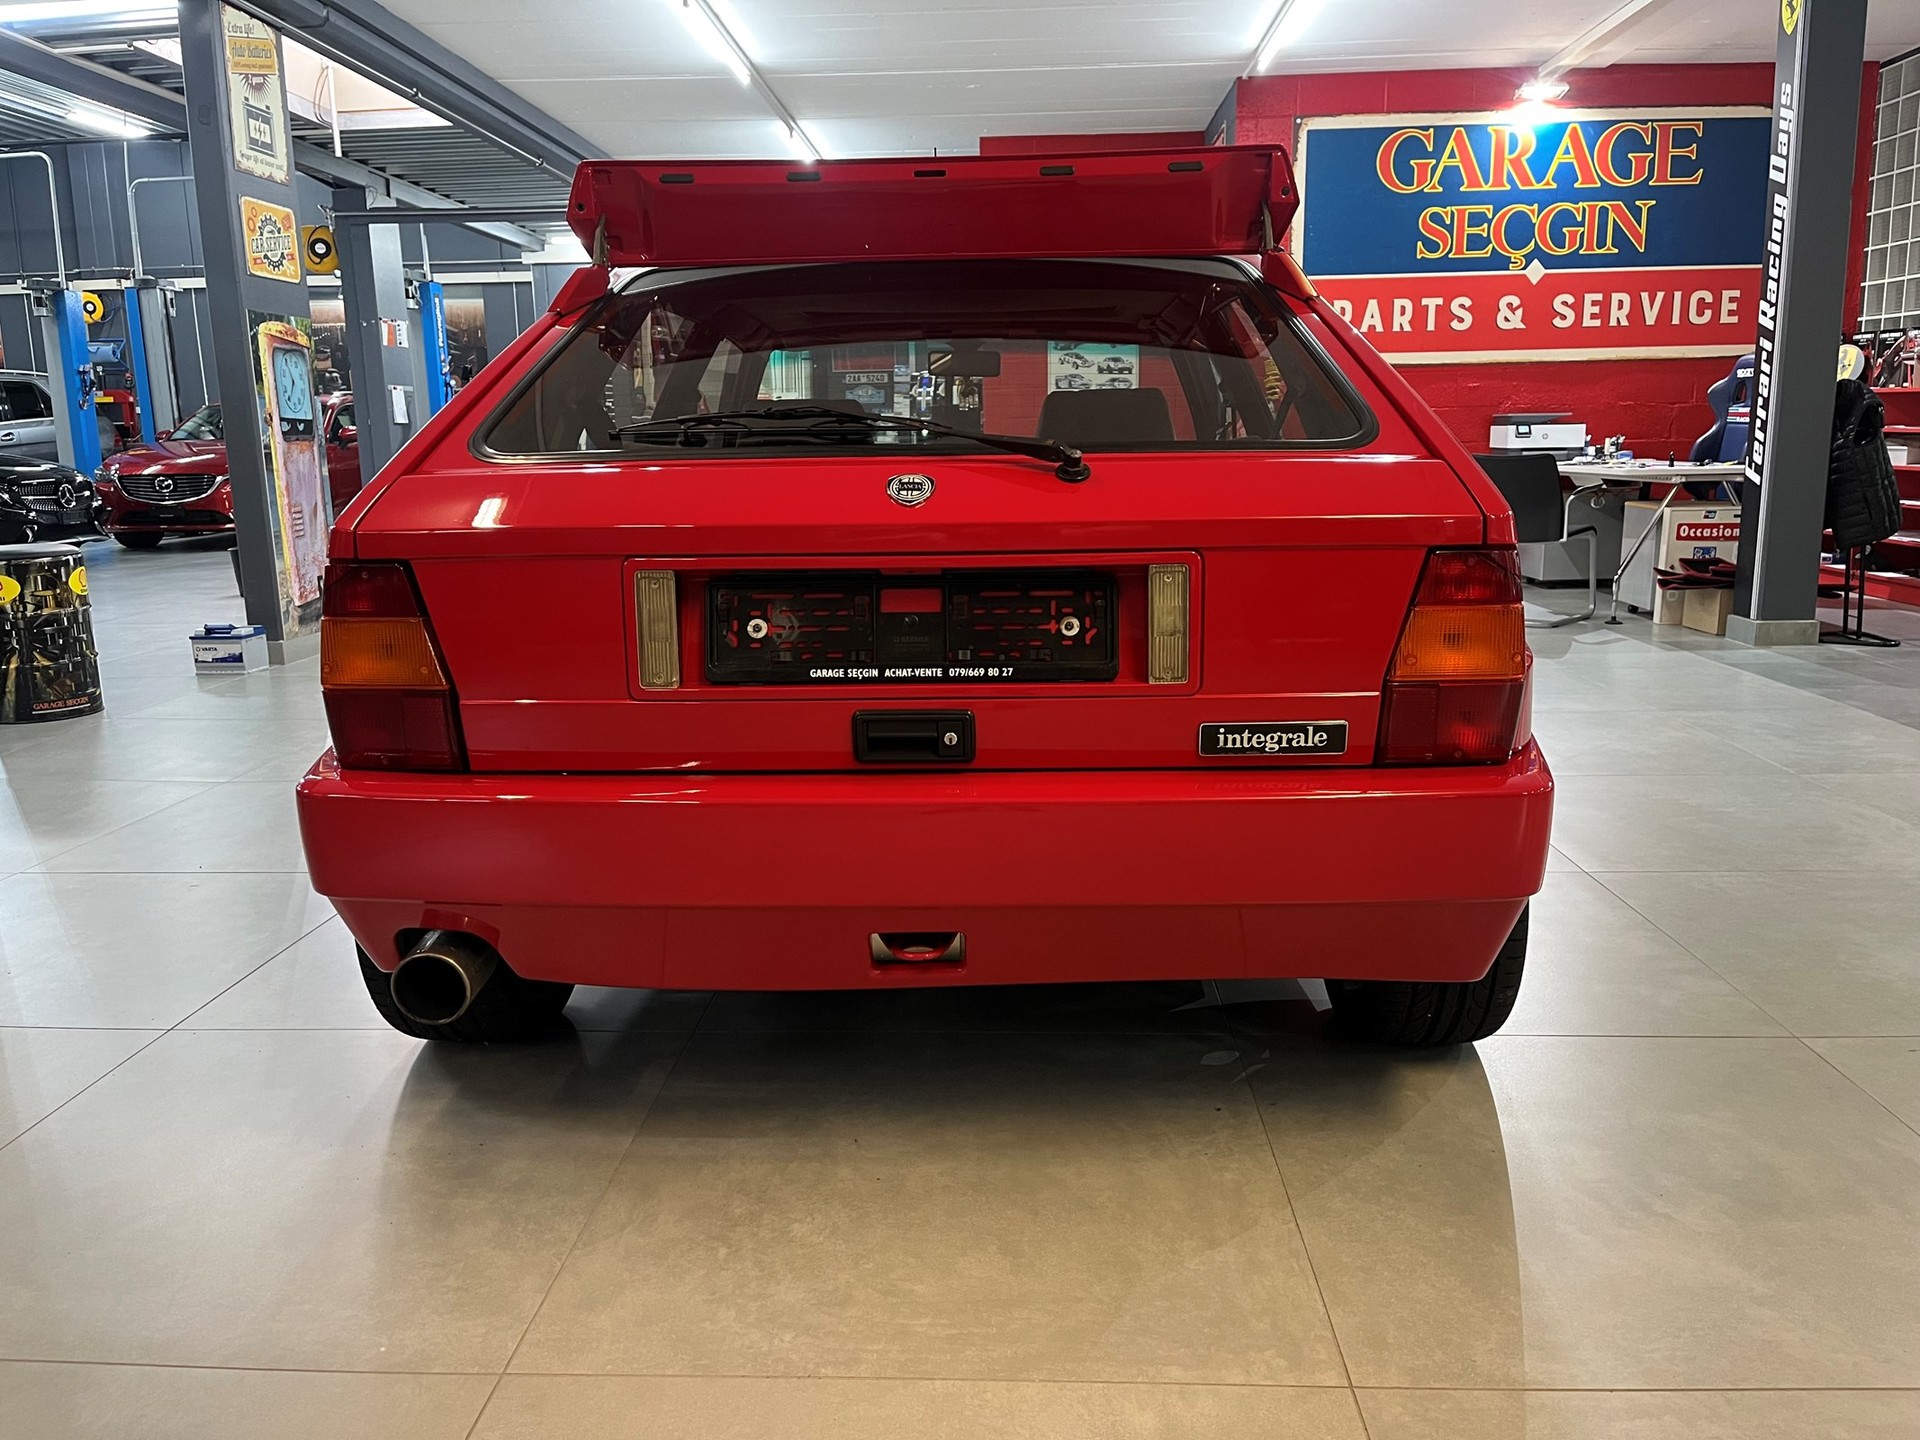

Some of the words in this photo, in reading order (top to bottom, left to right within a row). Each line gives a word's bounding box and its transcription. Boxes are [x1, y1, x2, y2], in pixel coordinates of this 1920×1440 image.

[1769, 82, 1794, 184] Days
[1376, 121, 1704, 194] GARAGE
[251, 237, 265, 254] CAR
[265, 234, 291, 253] SERVICE
[1416, 200, 1657, 270] SEÇGIN
[1758, 193, 1788, 331] Racing
[1496, 294, 1526, 330] &
[1552, 289, 1741, 328] SERVICE
[1745, 336, 1773, 486] Ferrari
[1680, 525, 1740, 537] Occasion
[810, 669, 845, 678] GARAGE
[847, 668, 879, 679] SEÇGIN
[884, 668, 943, 677] ACHAT-VENTE
[949, 667, 985, 677] 079/669
[987, 668, 999, 676] 80
[1002, 668, 1013, 676] 27
[33, 700, 65, 710] GARAGE
[1217, 726, 1328, 752] integrale
